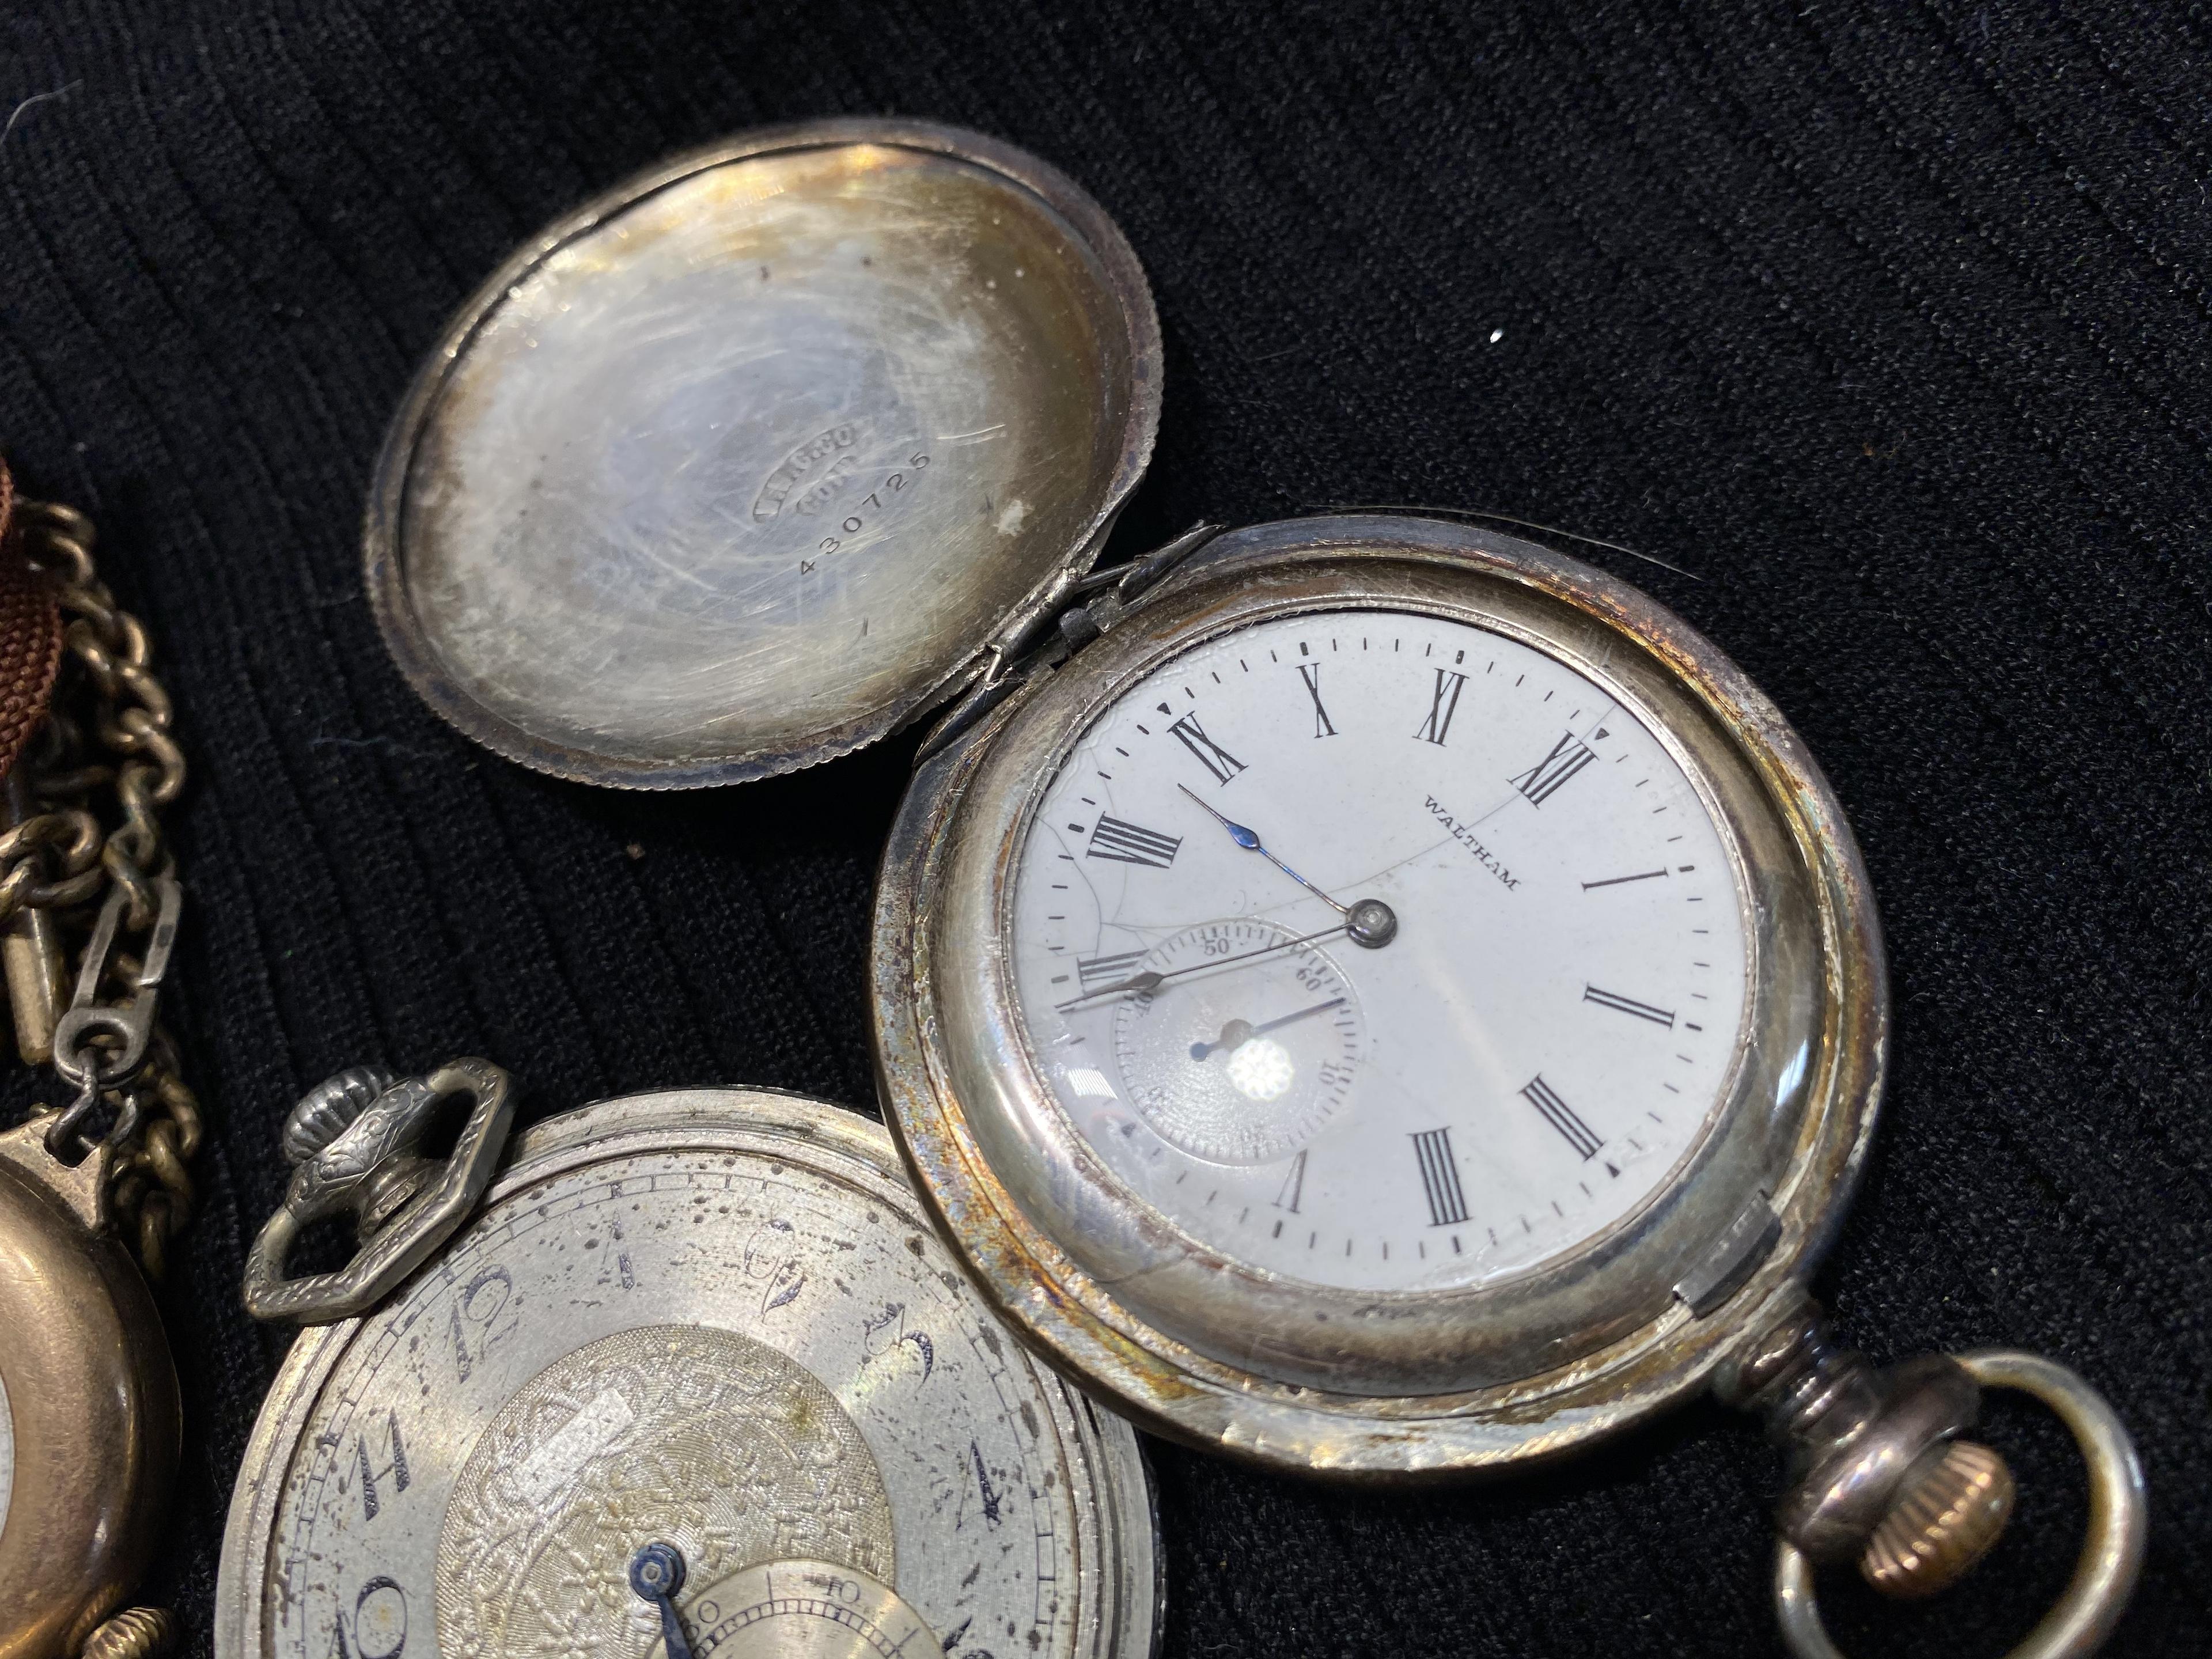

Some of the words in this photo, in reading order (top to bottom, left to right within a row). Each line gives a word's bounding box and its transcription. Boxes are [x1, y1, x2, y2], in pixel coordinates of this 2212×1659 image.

[801, 451, 930, 575] 430725
[1294, 662, 1339, 738] X
[1412, 668, 1469, 747] XI
[1166, 711, 1248, 786] IX
[1505, 729, 1599, 809] XII
[1086, 811, 1183, 868] VIII
[1424, 795, 1521, 891] WALTHAM
[1205, 937, 1230, 956] 50
[1296, 968, 1321, 991] 60
[1584, 981, 1675, 1030] II
[1518, 1073, 1605, 1161] III
[744, 1218, 809, 1323] 2
